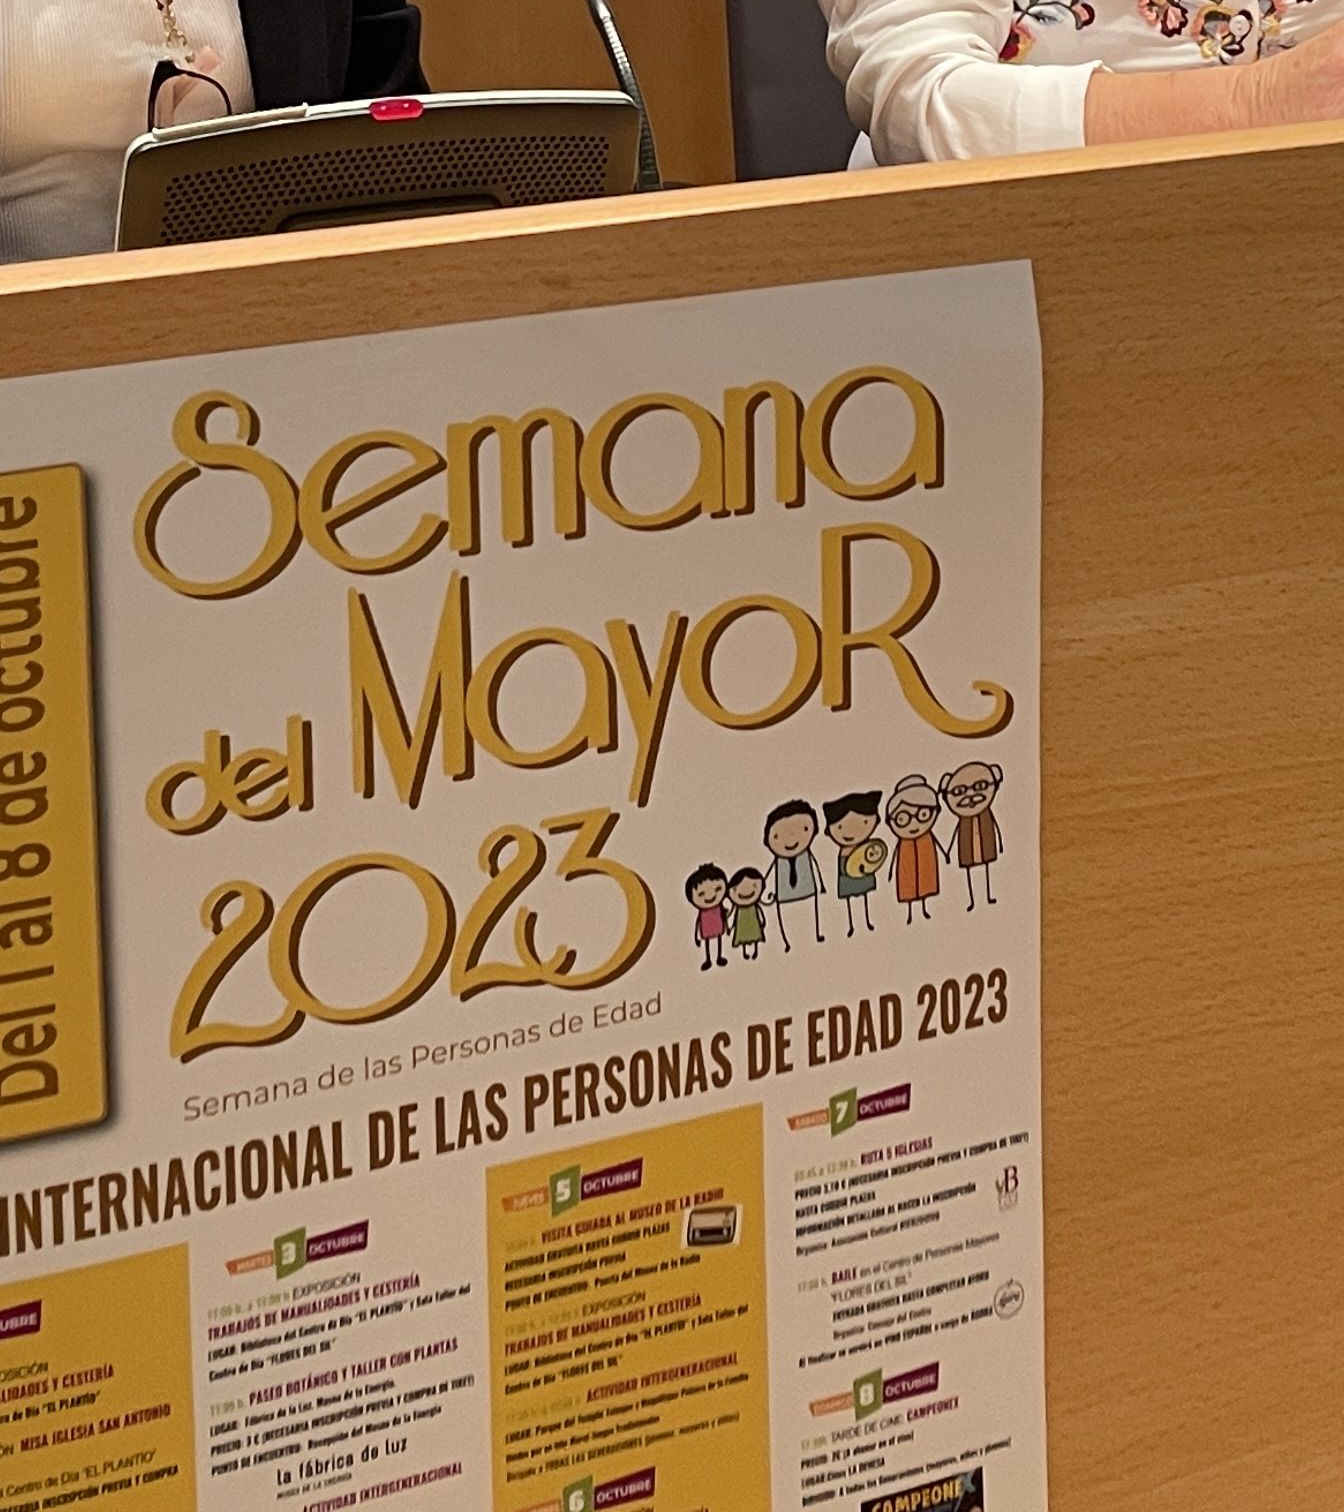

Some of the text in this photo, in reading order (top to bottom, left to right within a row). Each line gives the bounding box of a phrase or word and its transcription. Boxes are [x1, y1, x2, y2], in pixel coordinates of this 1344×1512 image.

[133, 366, 945, 600] Semana
[146, 715, 313, 836] del
[170, 807, 658, 1063] 2023
[182, 991, 662, 1122] Semana de las Personas de Edad
[367, 1109, 424, 1171] DE
[433, 1100, 512, 1158] LAS
[525, 1035, 733, 1131] PERSONAS
[745, 1026, 797, 1082] DE
[805, 1008, 903, 1074] EDAD
[915, 966, 1007, 1052] 2023
[836, 1094, 907, 1123] 7 OCTUBRE
[556, 1171, 639, 1202] 5 OCTUBRE
[281, 1233, 364, 1265] 3 OCTUBRE
[52, 1378, 58, 1391] Y
[62, 1363, 114, 1388] CESTERÍA
[249, 1337, 458, 1406] PASEO BOTÁNICO Y TALLER CON PLANTAS
[859, 1373, 936, 1406] 8 OCTUBRE
[20, 1435, 49, 1452] MISA
[52, 1422, 94, 1445] IGLESIA
[99, 1416, 121, 1434] SAN
[124, 1403, 171, 1428] ANTONIO
[276, 1437, 407, 1485] la fábrica de luz
[7, 1481, 42, 1497] Centro
[45, 1476, 58, 1488] de
[568, 1479, 651, 1512] 6 OCTUBRE
